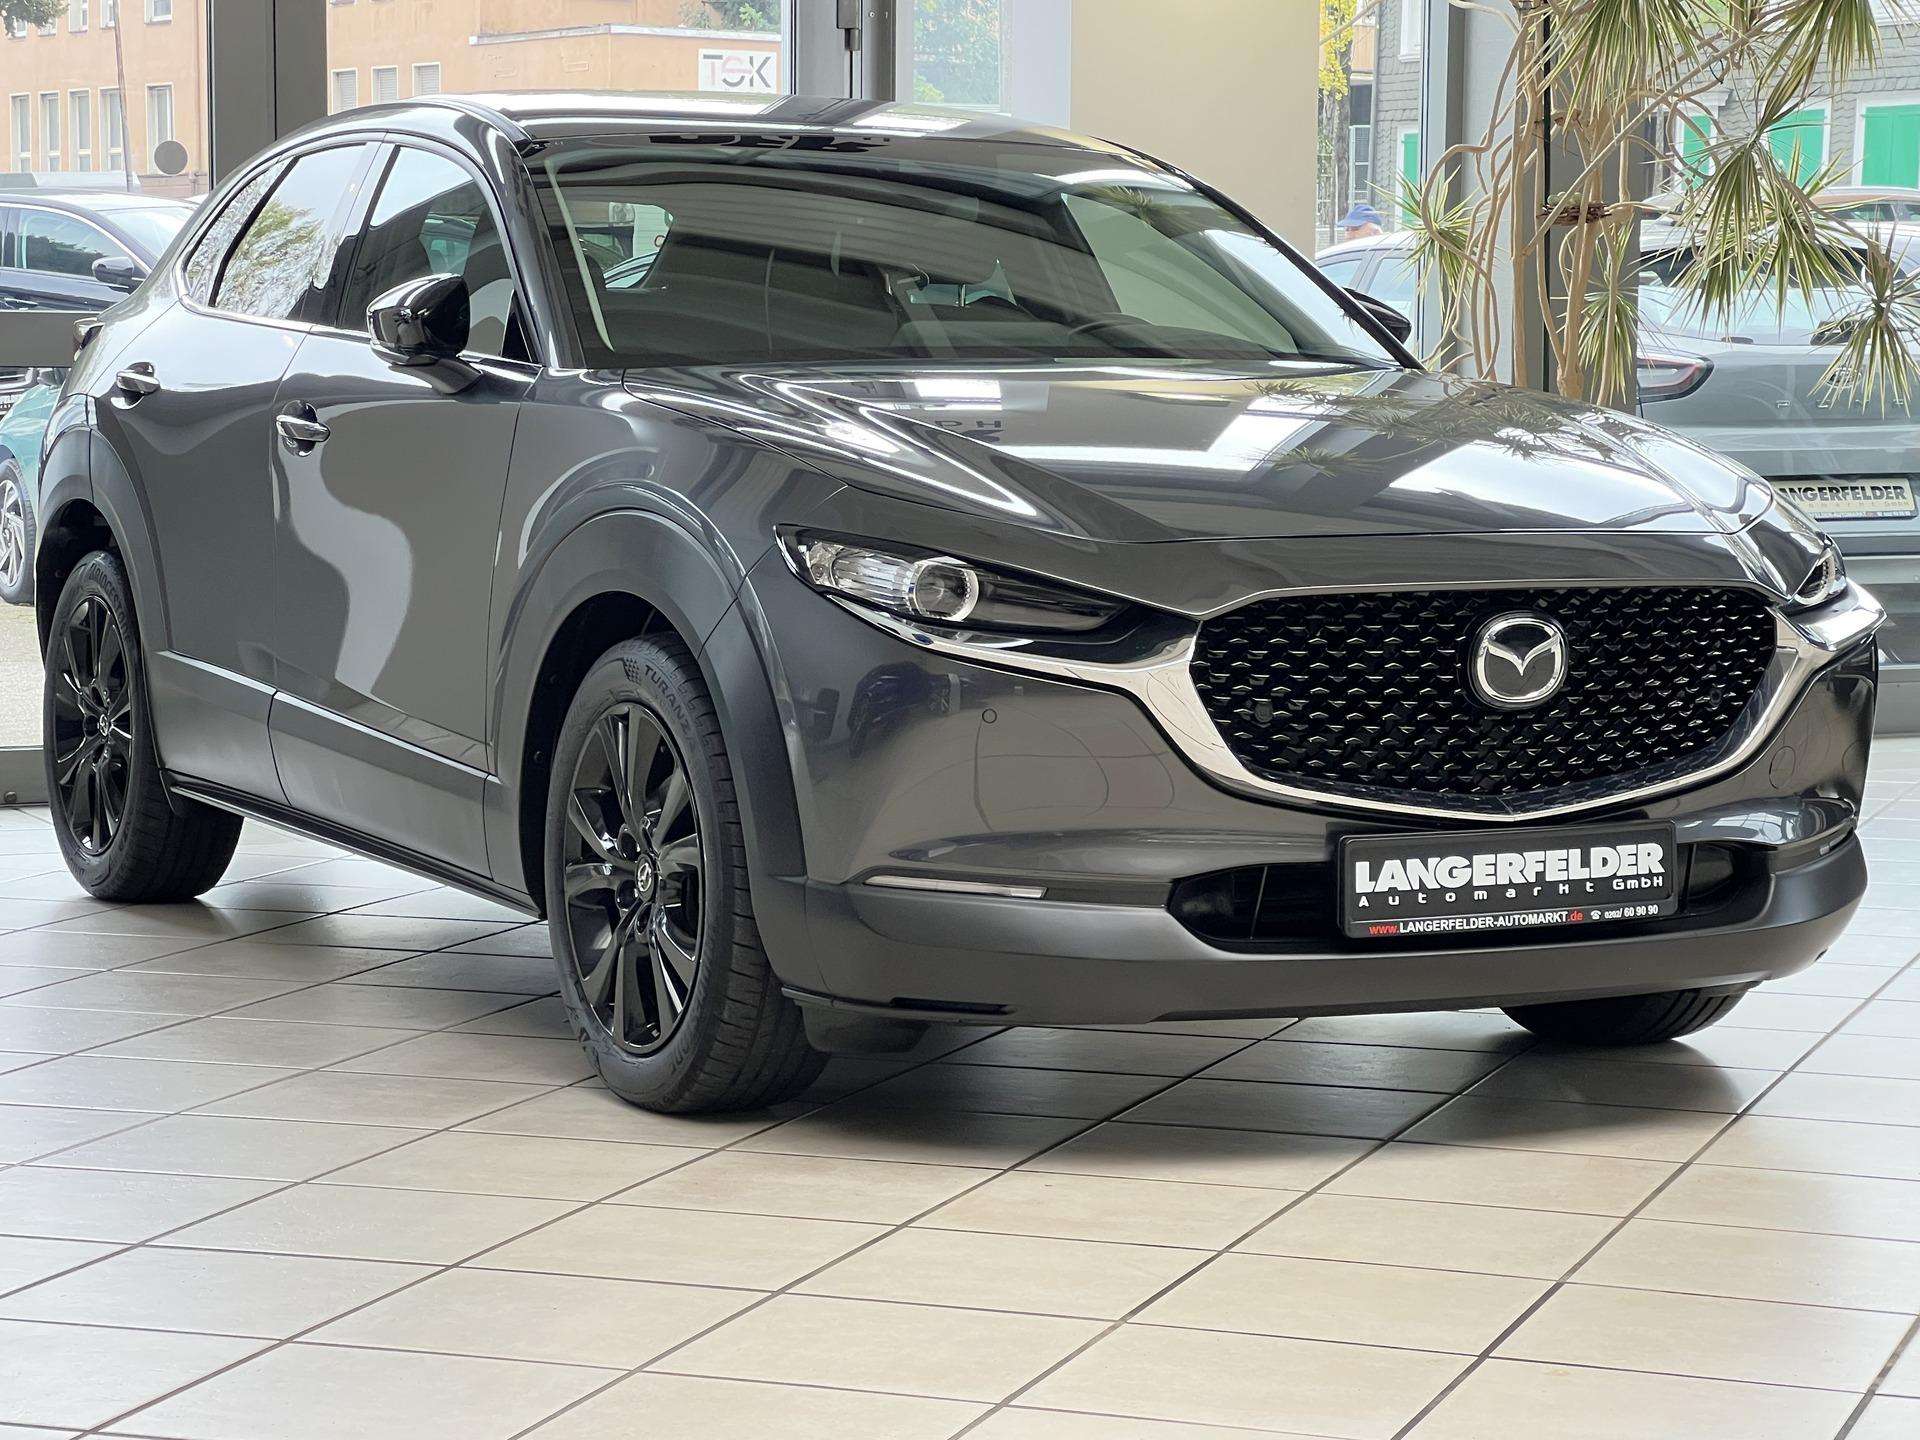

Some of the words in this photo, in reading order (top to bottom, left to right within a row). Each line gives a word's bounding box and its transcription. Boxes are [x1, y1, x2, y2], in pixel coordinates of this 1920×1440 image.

[1779, 485, 1906, 502] NGERFELDER
[1355, 842, 1665, 893] LANGERFELDER
[1612, 875, 1664, 891] GmbH
[1368, 910, 1584, 935] www.LANGERFELDER-AUTOMARKT.de
